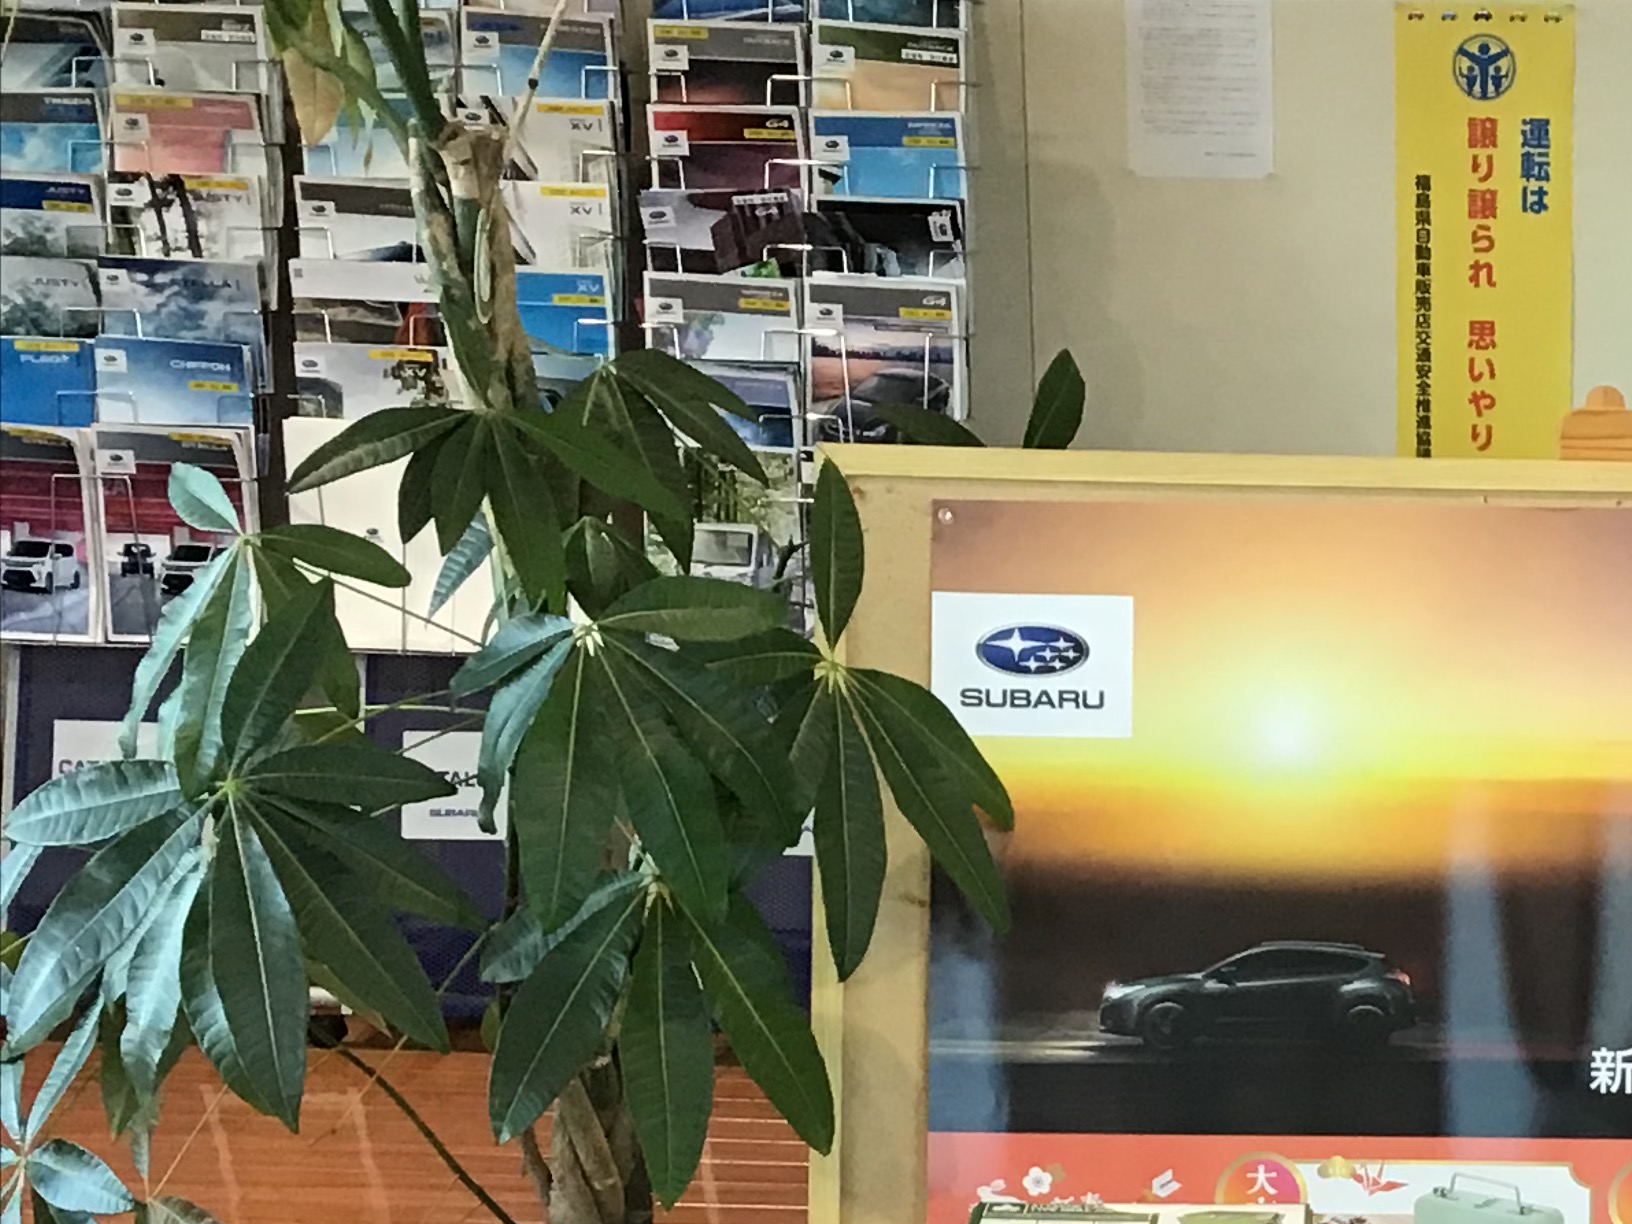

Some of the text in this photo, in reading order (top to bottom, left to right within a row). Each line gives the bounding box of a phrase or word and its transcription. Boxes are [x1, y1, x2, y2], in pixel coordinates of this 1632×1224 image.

[1520, 118, 1551, 215] 運転は
[1467, 117, 1498, 452] 譲り譲られ 思いやり
[959, 687, 1105, 710] SUBARU
[429, 809, 479, 817] SUBAR
